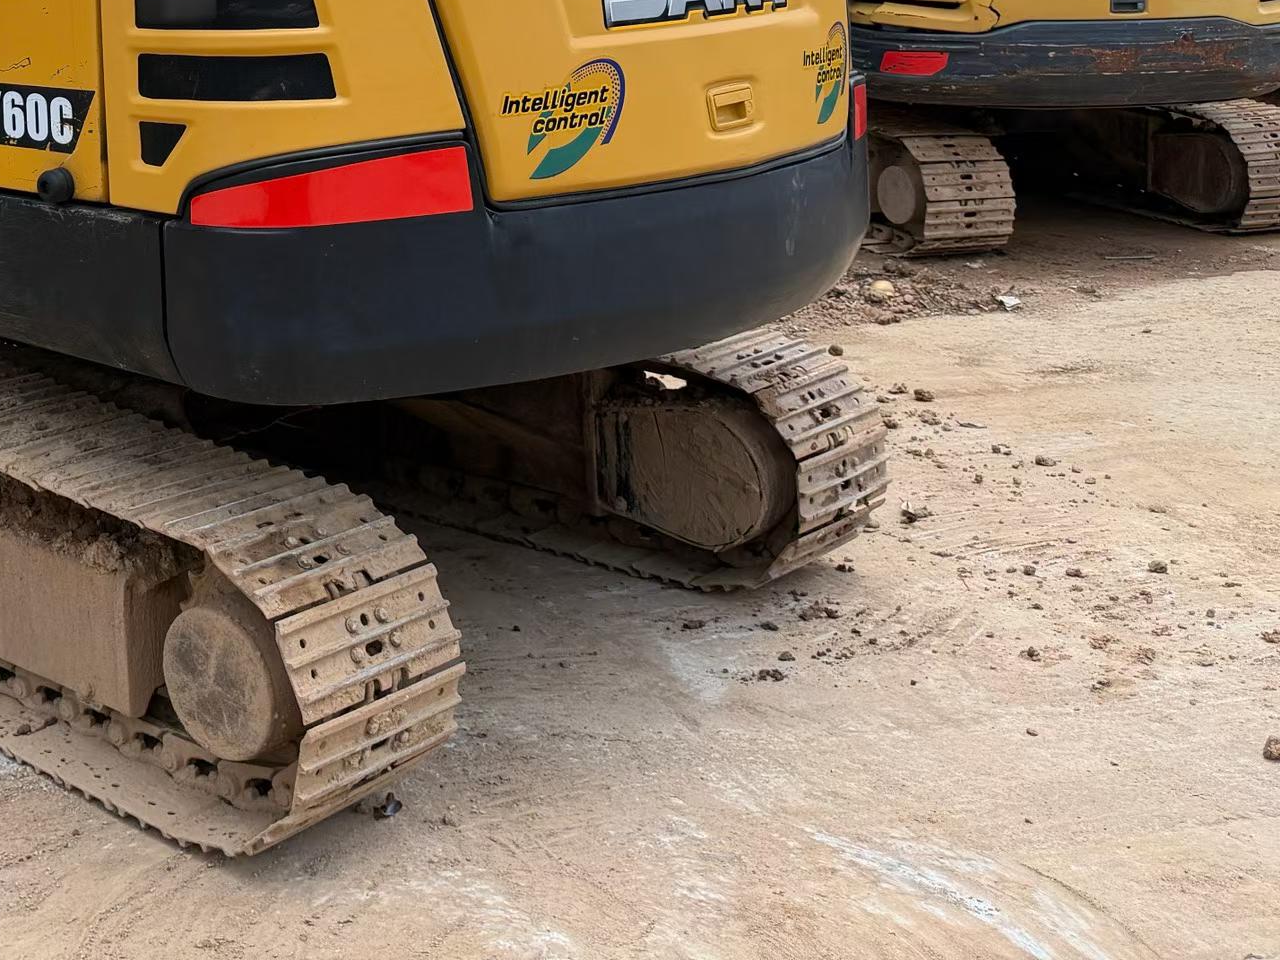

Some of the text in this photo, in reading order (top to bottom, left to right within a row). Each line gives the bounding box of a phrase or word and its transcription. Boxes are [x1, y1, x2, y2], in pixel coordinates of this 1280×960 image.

[803, 45, 842, 67] Intelligent
[501, 85, 609, 115] Intelligent
[532, 106, 606, 134] control
